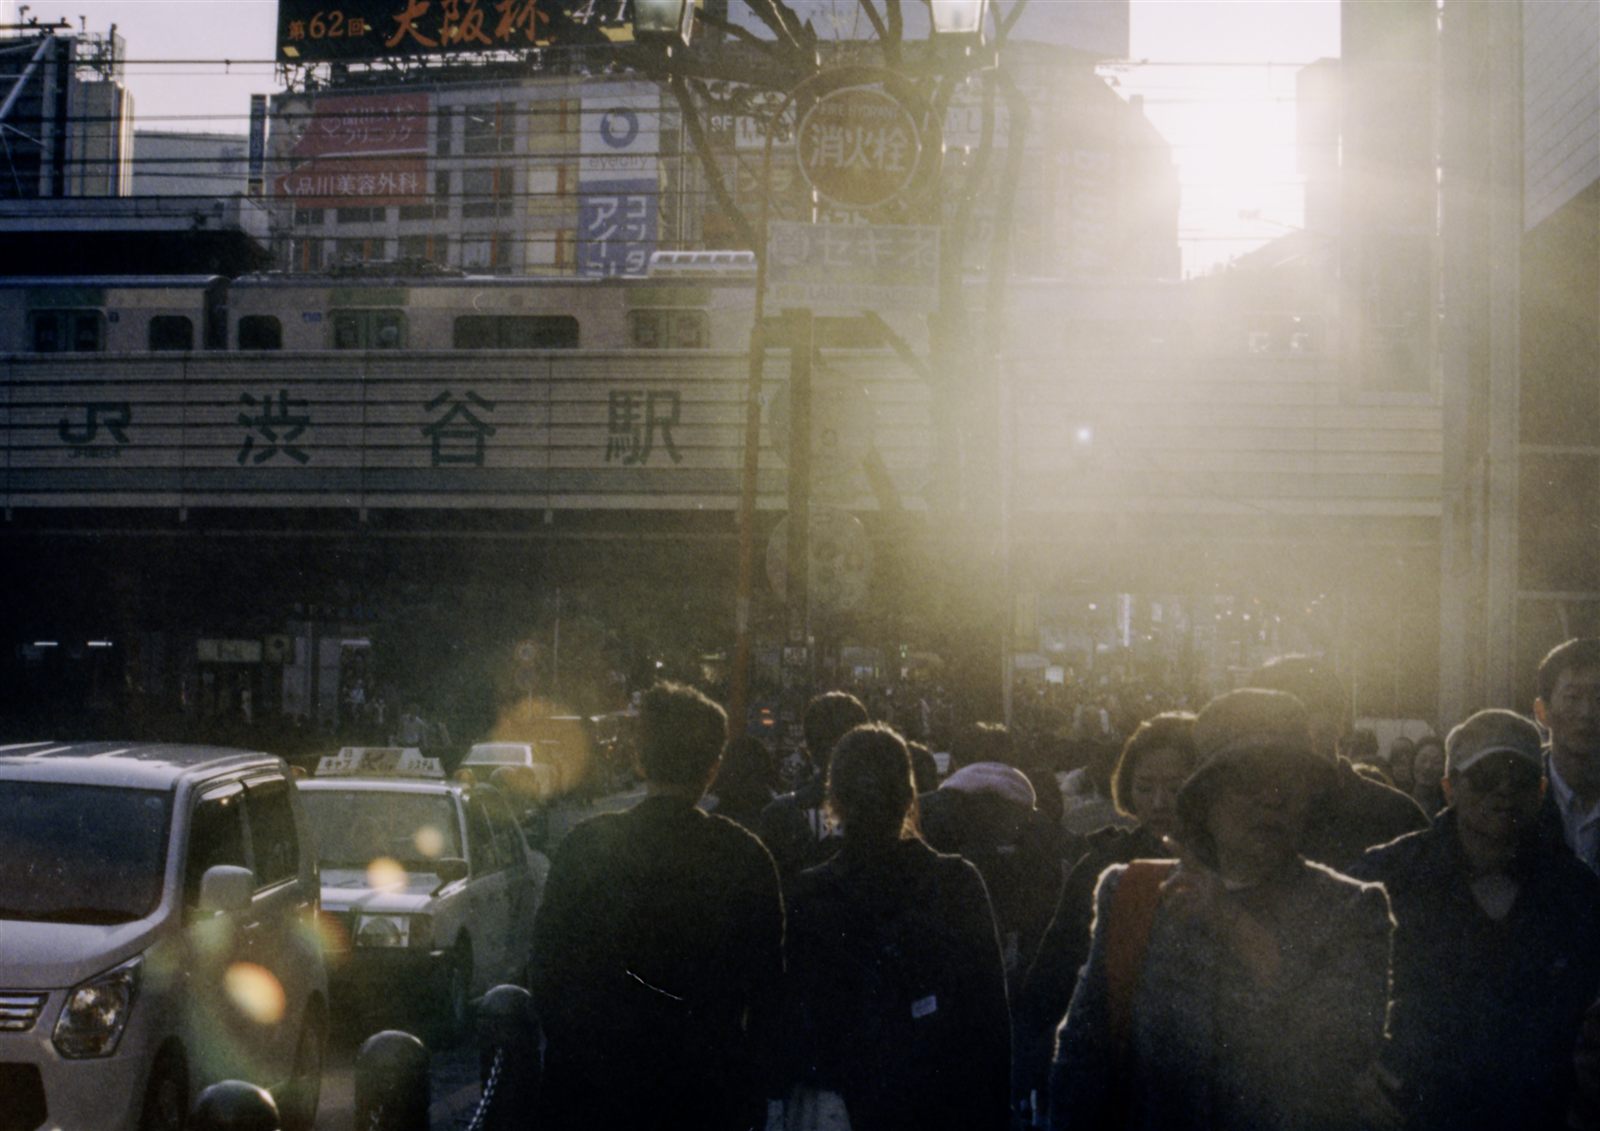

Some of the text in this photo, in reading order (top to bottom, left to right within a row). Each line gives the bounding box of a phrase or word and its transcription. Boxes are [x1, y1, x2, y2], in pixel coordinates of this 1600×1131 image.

[288, 10, 366, 40] 第62回
[385, 0, 552, 47] 大阪杯
[345, 126, 412, 145] クリニック
[809, 124, 908, 171] 消火栓
[296, 172, 418, 195] 品川美容外科
[59, 390, 683, 466] JR 渋谷駅
